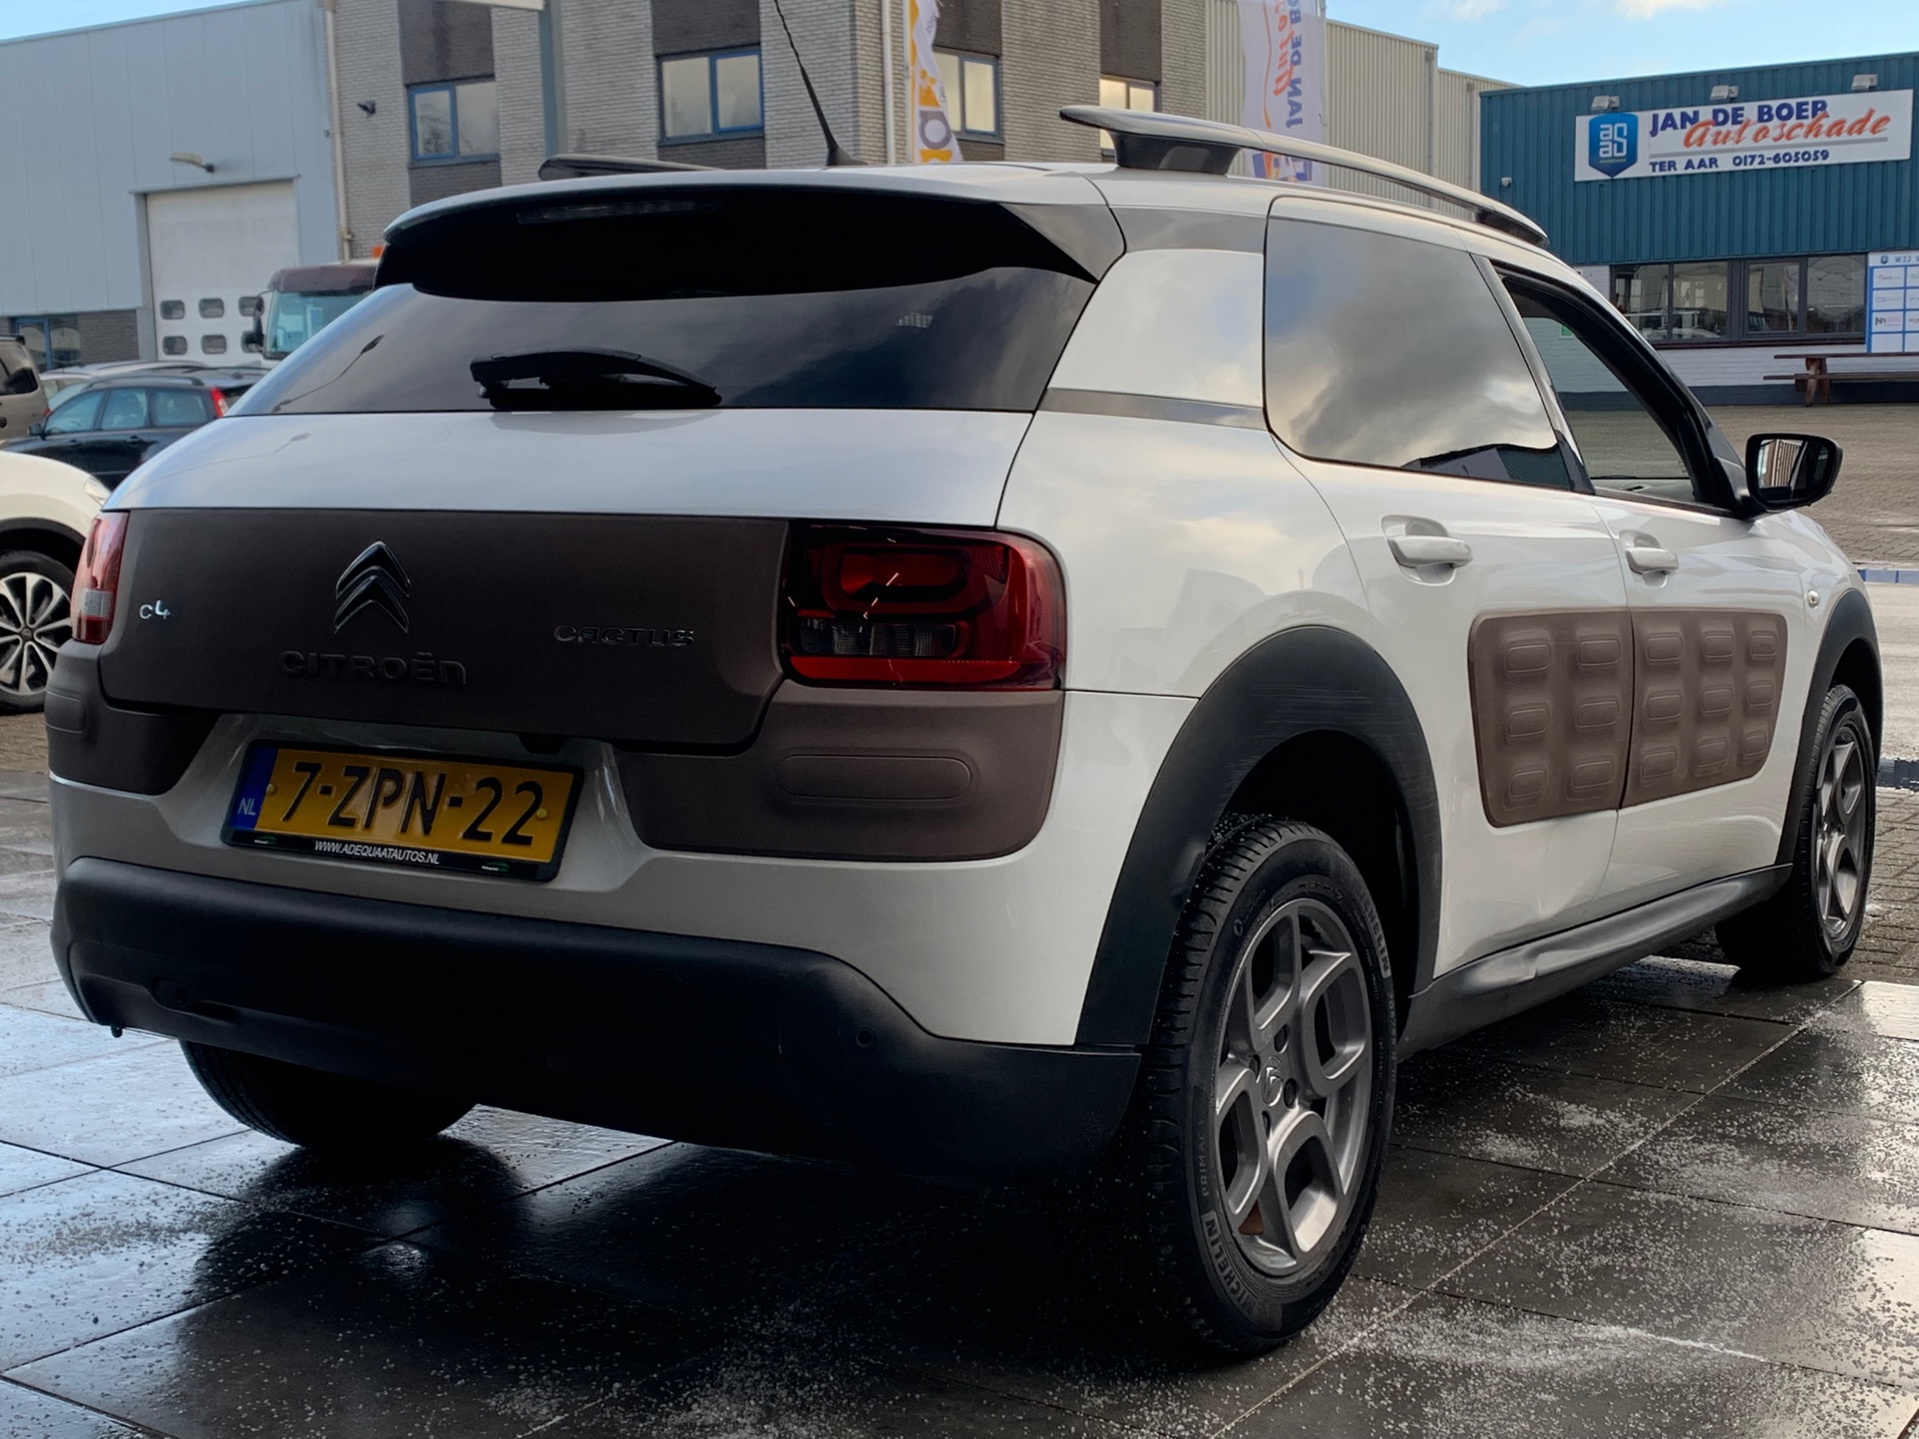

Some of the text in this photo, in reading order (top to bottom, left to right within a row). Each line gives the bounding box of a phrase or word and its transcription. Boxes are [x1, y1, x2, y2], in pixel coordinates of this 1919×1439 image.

[1649, 99, 1829, 138] JAN DE BOER
[1649, 149, 1830, 173] TER AAR 0172-605059
[552, 623, 696, 647] CACTUS
[237, 797, 256, 816] NL
[280, 760, 545, 846] 7-ZPN-22
[313, 839, 440, 865] WWW.ADEQUAATAUTOS.NL
[1205, 1217, 1259, 1315] MICHELIN
